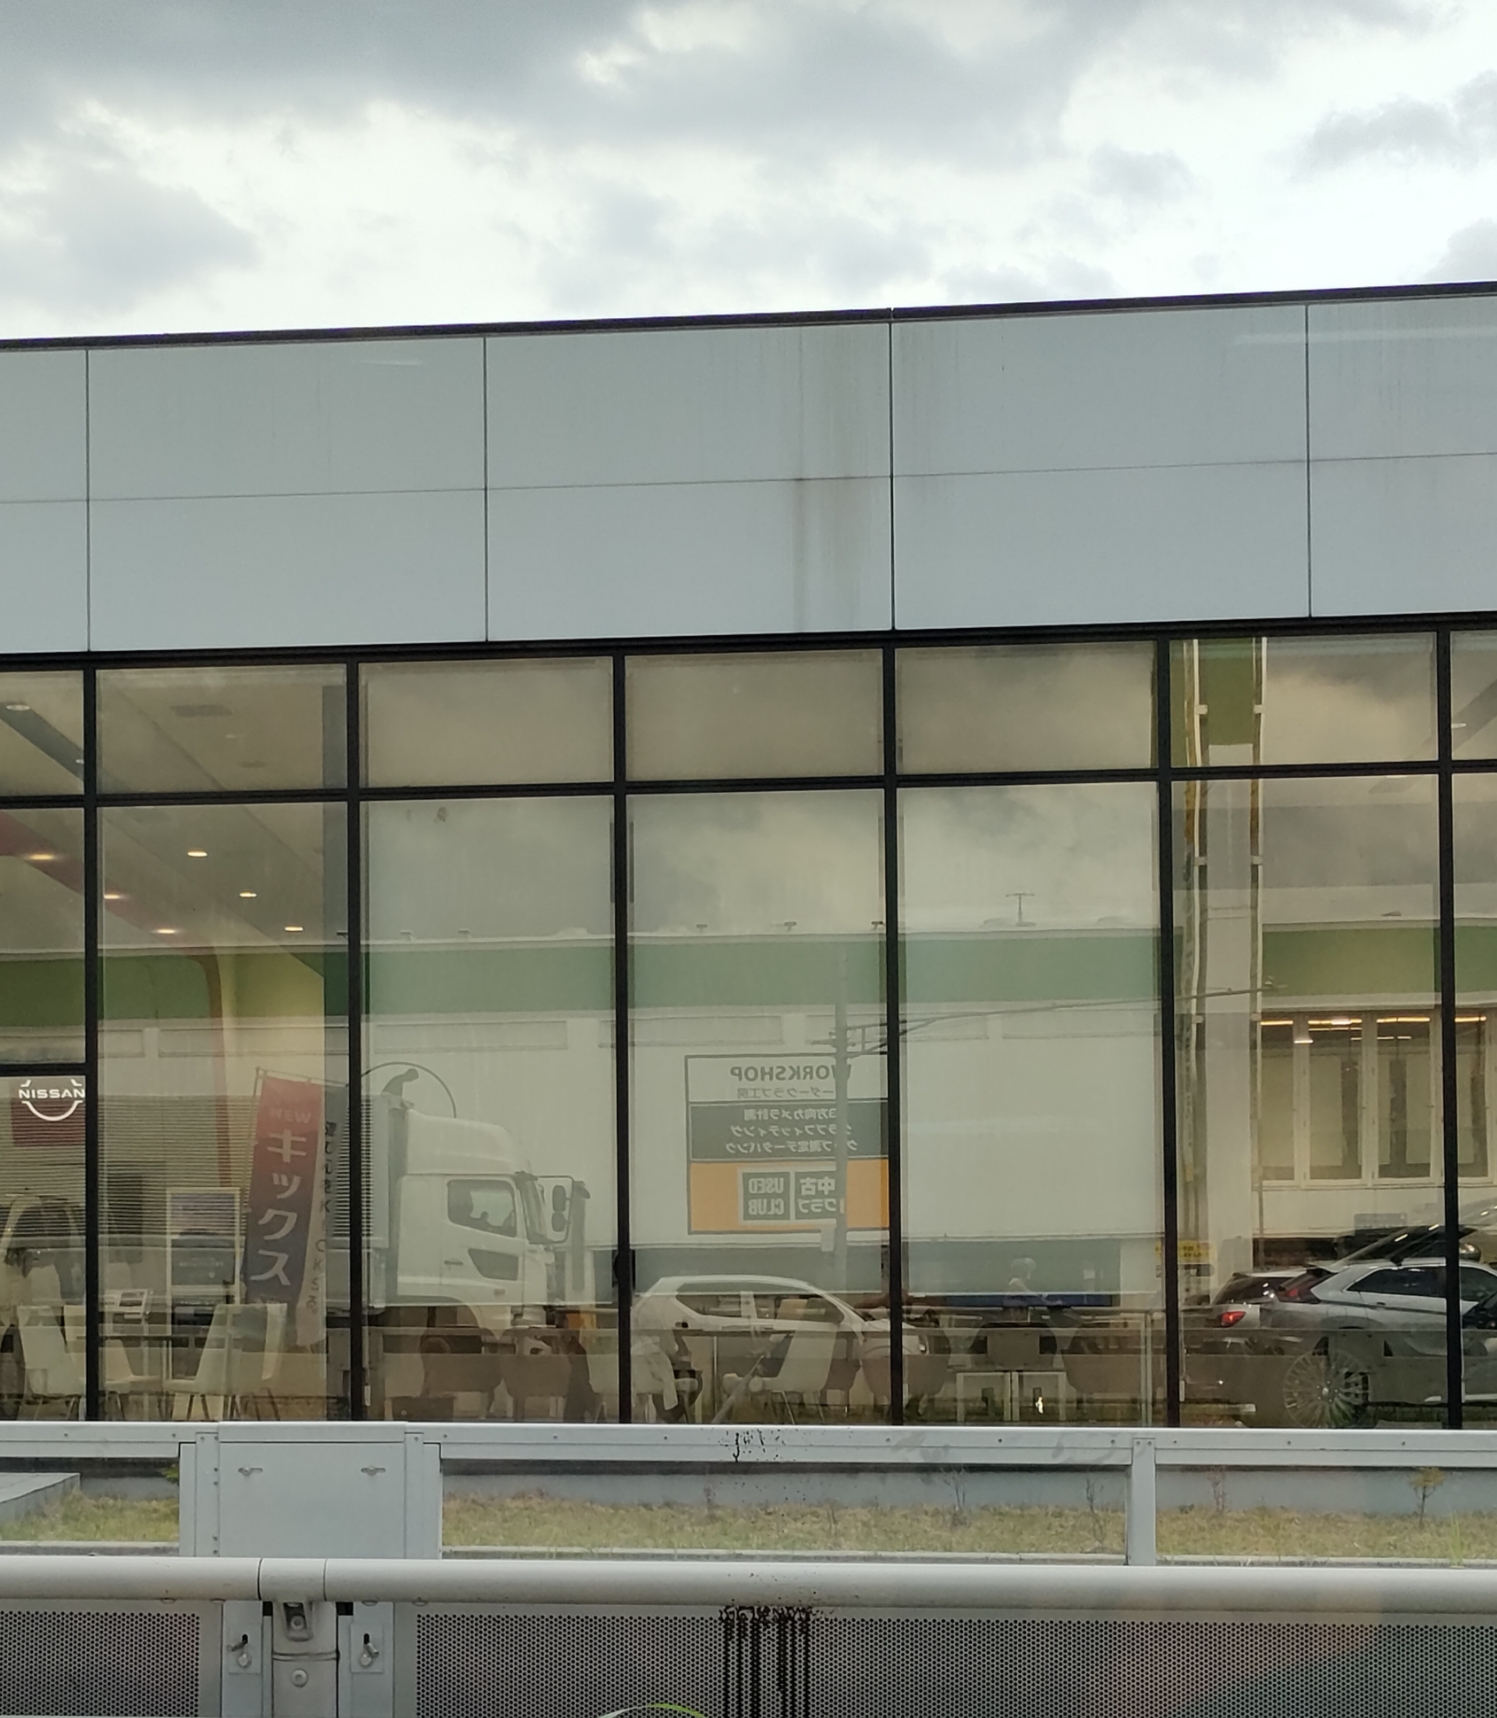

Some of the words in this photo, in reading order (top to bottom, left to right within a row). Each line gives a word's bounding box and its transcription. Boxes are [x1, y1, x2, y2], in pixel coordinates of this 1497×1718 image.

[18, 1089, 86, 1099] NISSAN
[270, 1107, 312, 1124] NEW
[249, 1128, 308, 1286] キックス
